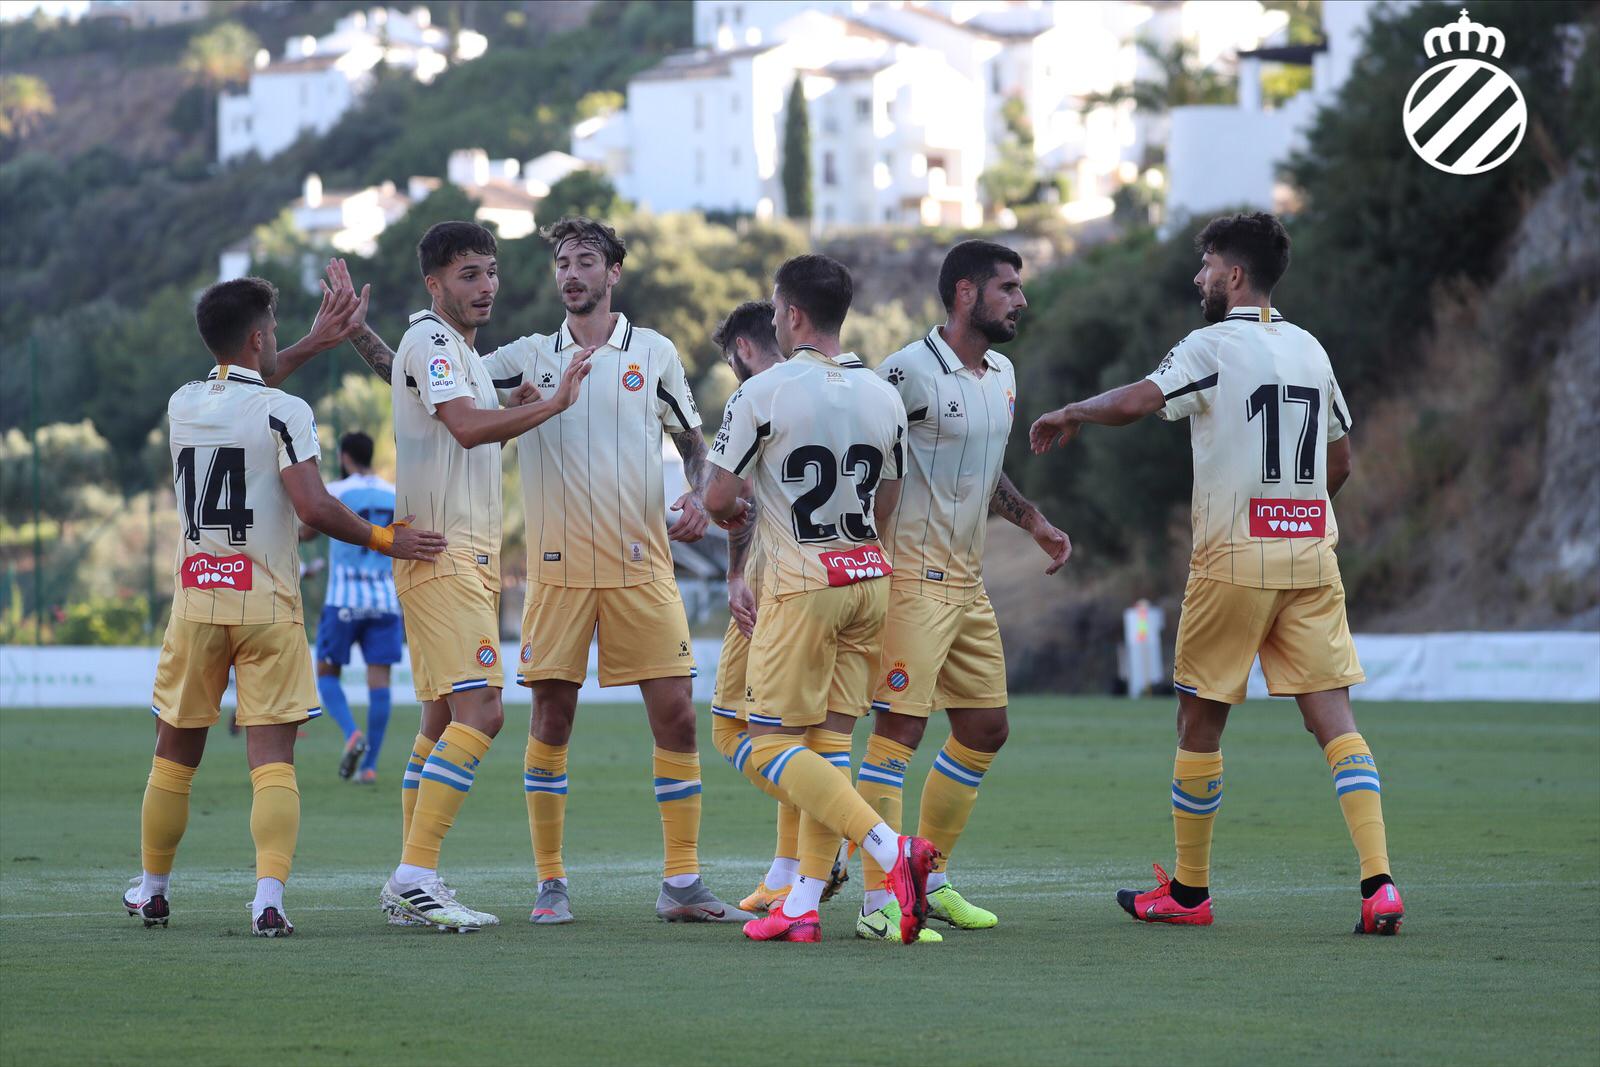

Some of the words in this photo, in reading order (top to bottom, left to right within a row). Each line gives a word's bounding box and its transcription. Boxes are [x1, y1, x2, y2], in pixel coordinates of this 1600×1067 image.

[1246, 384, 1321, 484] 17
[175, 447, 254, 545] 14
[781, 443, 884, 544] 23
